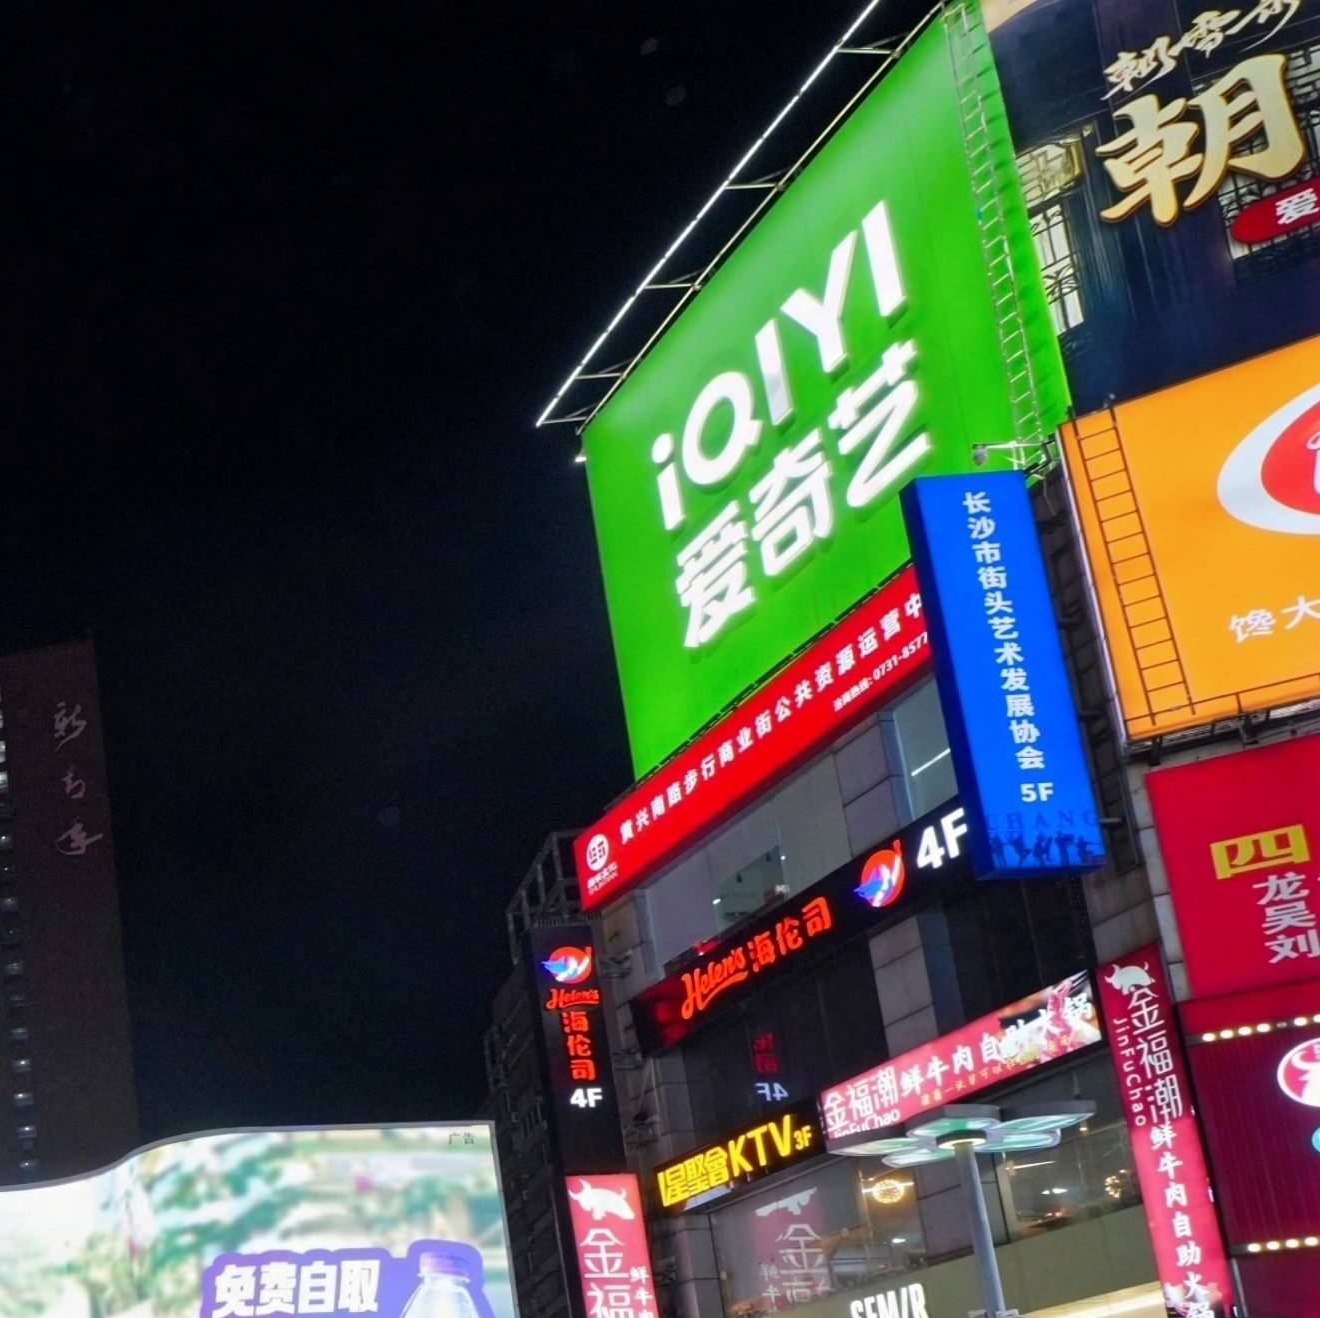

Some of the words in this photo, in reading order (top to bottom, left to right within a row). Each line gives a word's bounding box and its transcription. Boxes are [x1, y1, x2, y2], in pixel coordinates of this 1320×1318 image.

[674, 339, 933, 649] 爱奇艺
[963, 491, 1045, 770] 长沙市街头艺术发展协会
[1020, 782, 1054, 803] 5F
[916, 808, 969, 870] 4F
[747, 896, 833, 973] 海伦司
[561, 1011, 596, 1082] 海伦司
[1112, 1017, 1147, 1128] JinFuChao
[1128, 984, 1185, 1125] 金福潮
[570, 1087, 603, 1108] 4F
[823, 1065, 901, 1132] 金福潮
